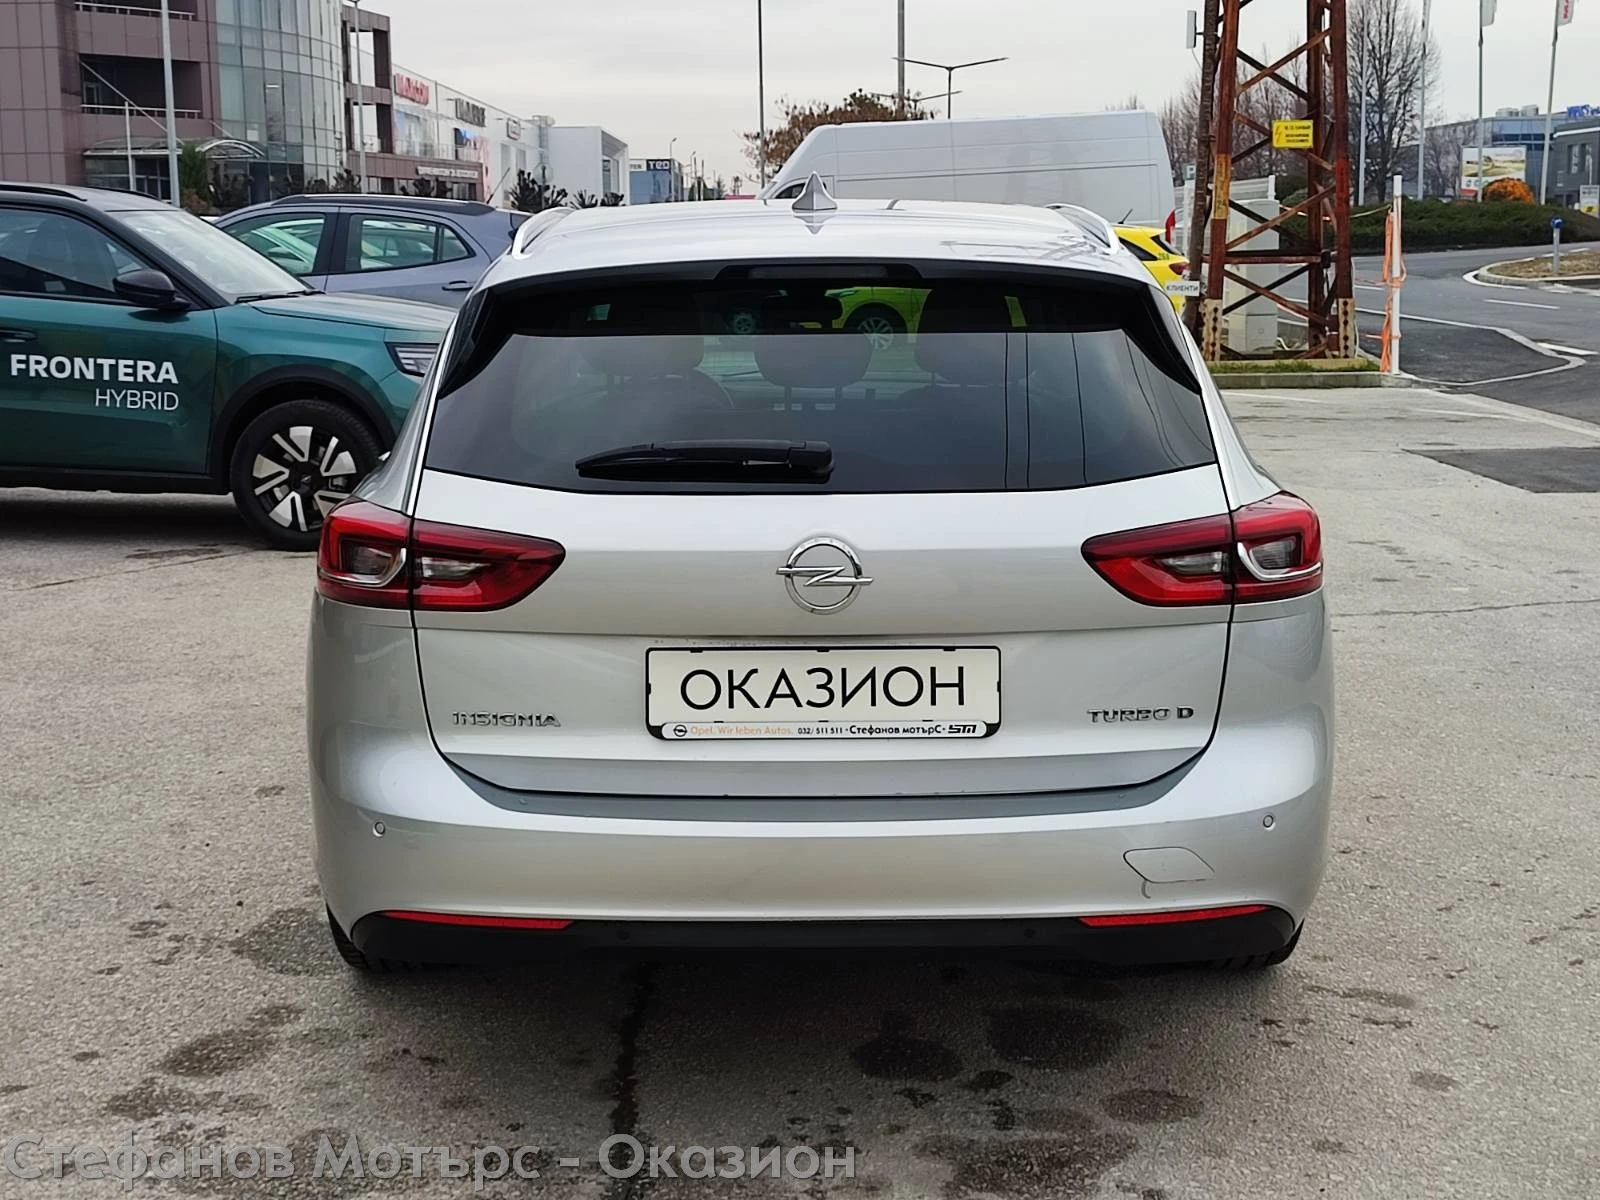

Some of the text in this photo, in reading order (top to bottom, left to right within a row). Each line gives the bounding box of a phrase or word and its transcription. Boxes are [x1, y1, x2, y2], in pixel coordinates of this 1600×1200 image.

[1166, 284, 1198, 292] КЛИЕНТИ
[10, 354, 179, 384] FRONTERA
[94, 388, 179, 411] HYBRID
[680, 666, 965, 710] ОКАЗИОН
[452, 711, 561, 727] INSIGNIA
[1087, 706, 1194, 723] TURBO D
[718, 726, 735, 735] Wir
[735, 726, 764, 735] leben
[816, 727, 828, 735] 511
[830, 727, 842, 735] 511
[849, 725, 900, 736] Стефанов
